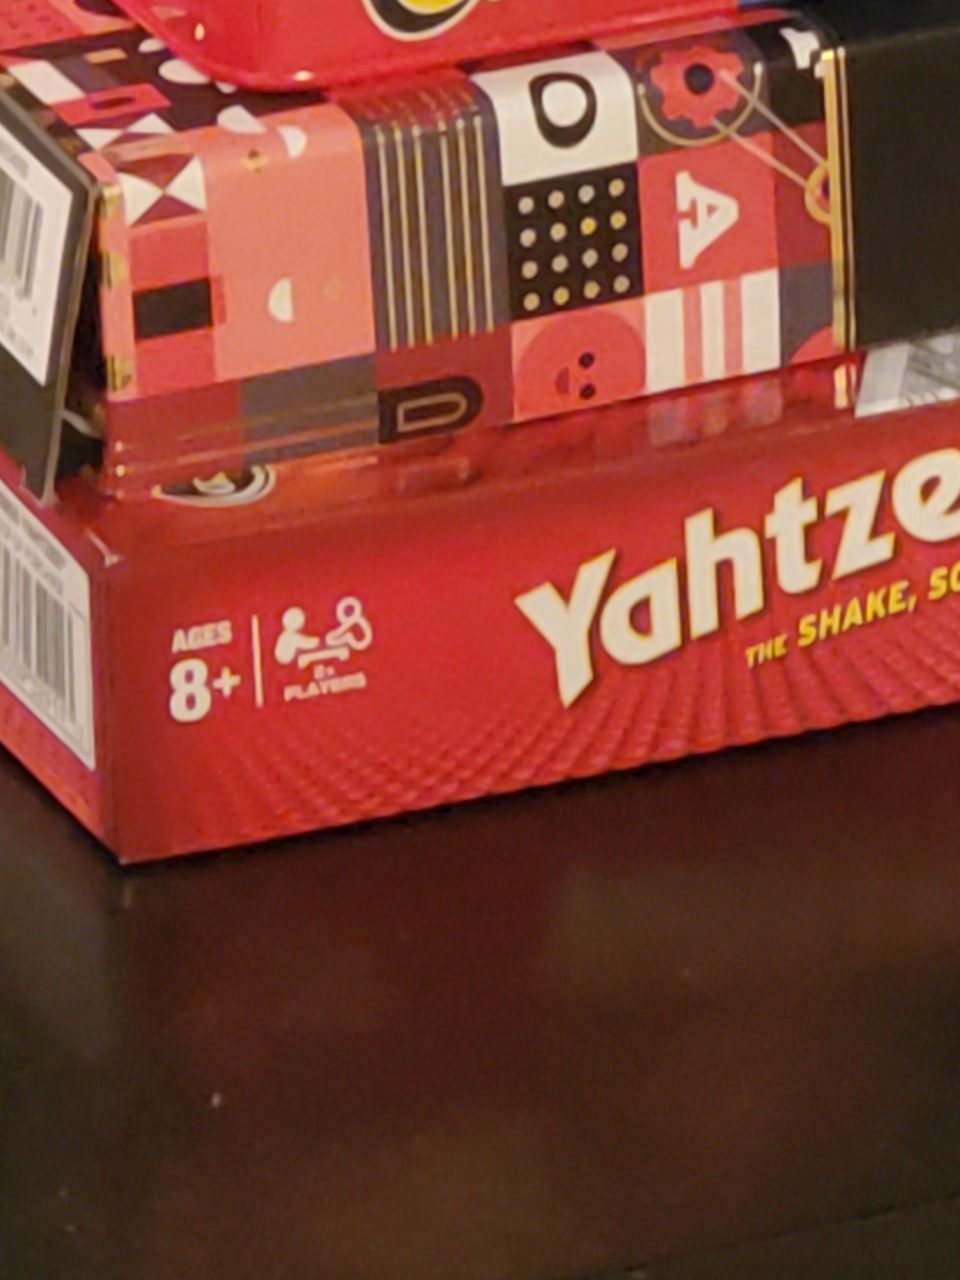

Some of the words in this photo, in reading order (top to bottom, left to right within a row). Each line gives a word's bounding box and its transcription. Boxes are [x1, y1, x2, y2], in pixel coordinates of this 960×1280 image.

[171, 619, 234, 654] AGES
[744, 632, 788, 670] THE
[797, 580, 917, 648] SHAKE,
[169, 657, 242, 723] 8+
